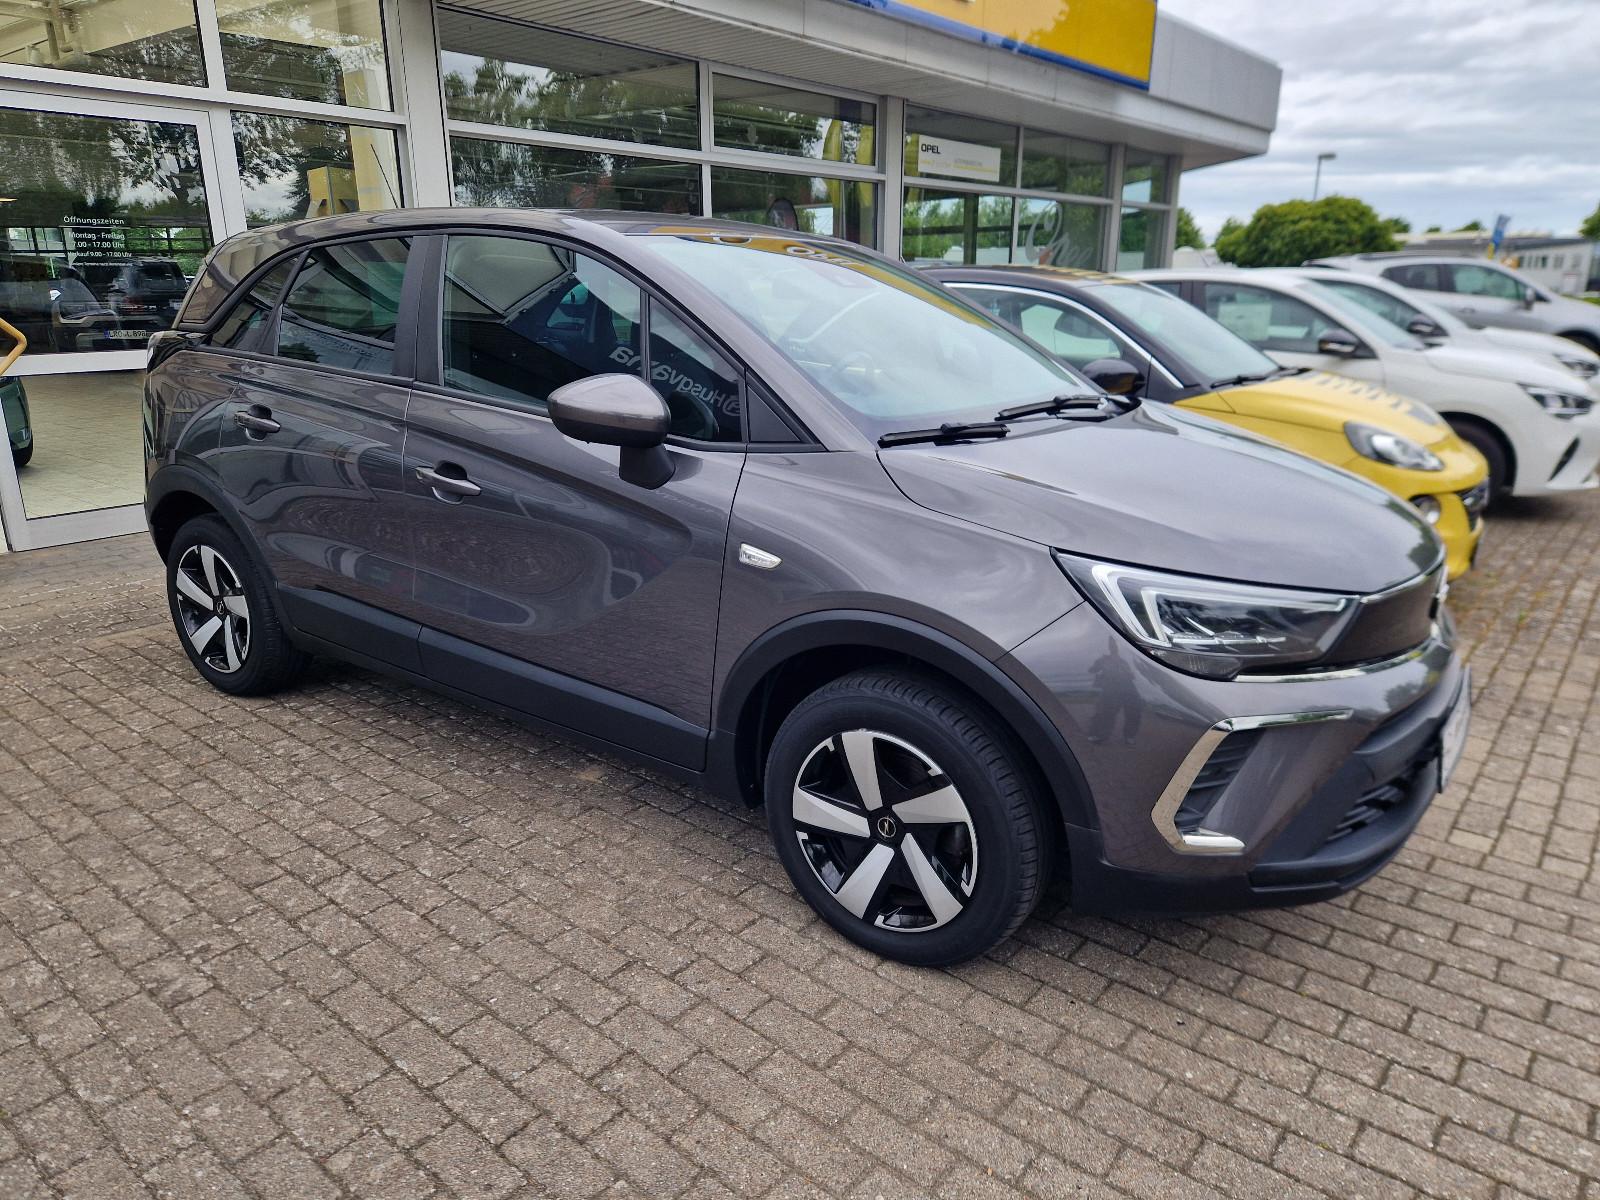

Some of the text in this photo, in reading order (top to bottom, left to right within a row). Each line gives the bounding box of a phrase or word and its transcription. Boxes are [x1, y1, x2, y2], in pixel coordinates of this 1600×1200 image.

[920, 143, 941, 155] OPEL
[63, 214, 125, 226] Öffnungszeiten
[68, 231, 97, 241] Montag
[101, 232, 126, 241] Freitag
[112, 241, 126, 249] Uhr
